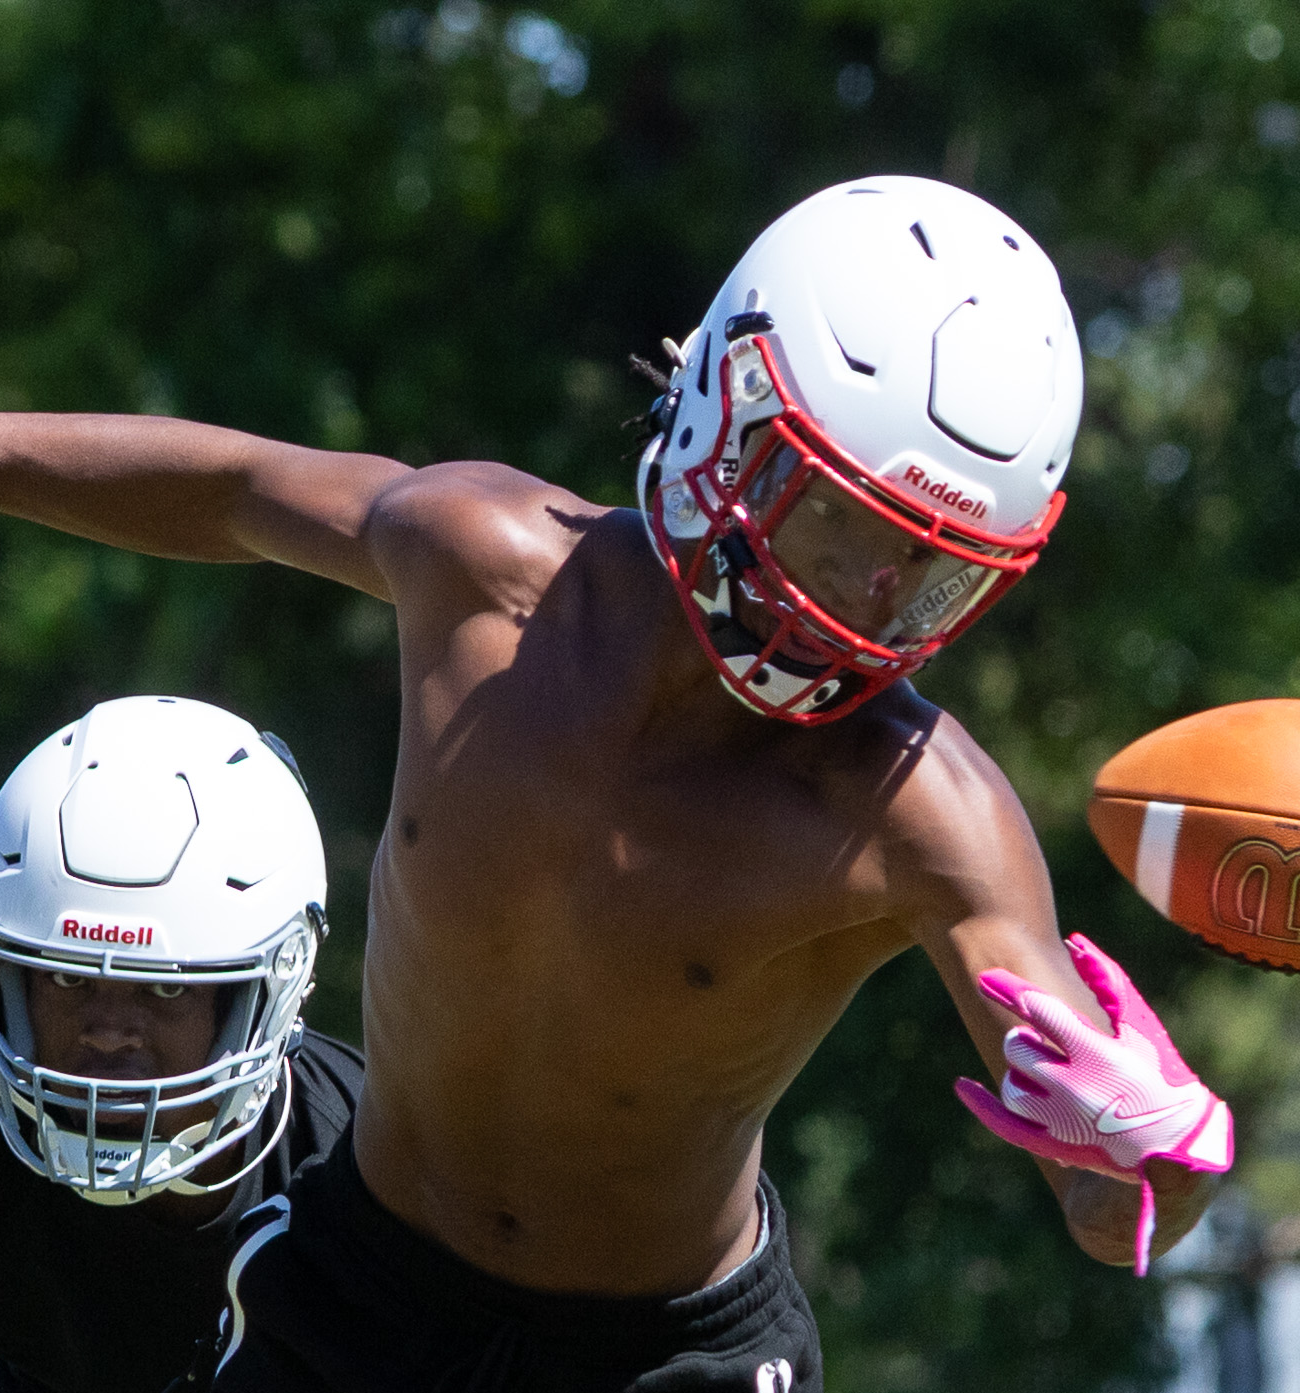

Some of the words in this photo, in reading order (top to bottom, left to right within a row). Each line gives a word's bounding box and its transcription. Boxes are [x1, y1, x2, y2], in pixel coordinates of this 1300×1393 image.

[904, 464, 987, 519] Riddell
[62, 919, 153, 946] Riddell
[86, 1149, 133, 1162] iddell
